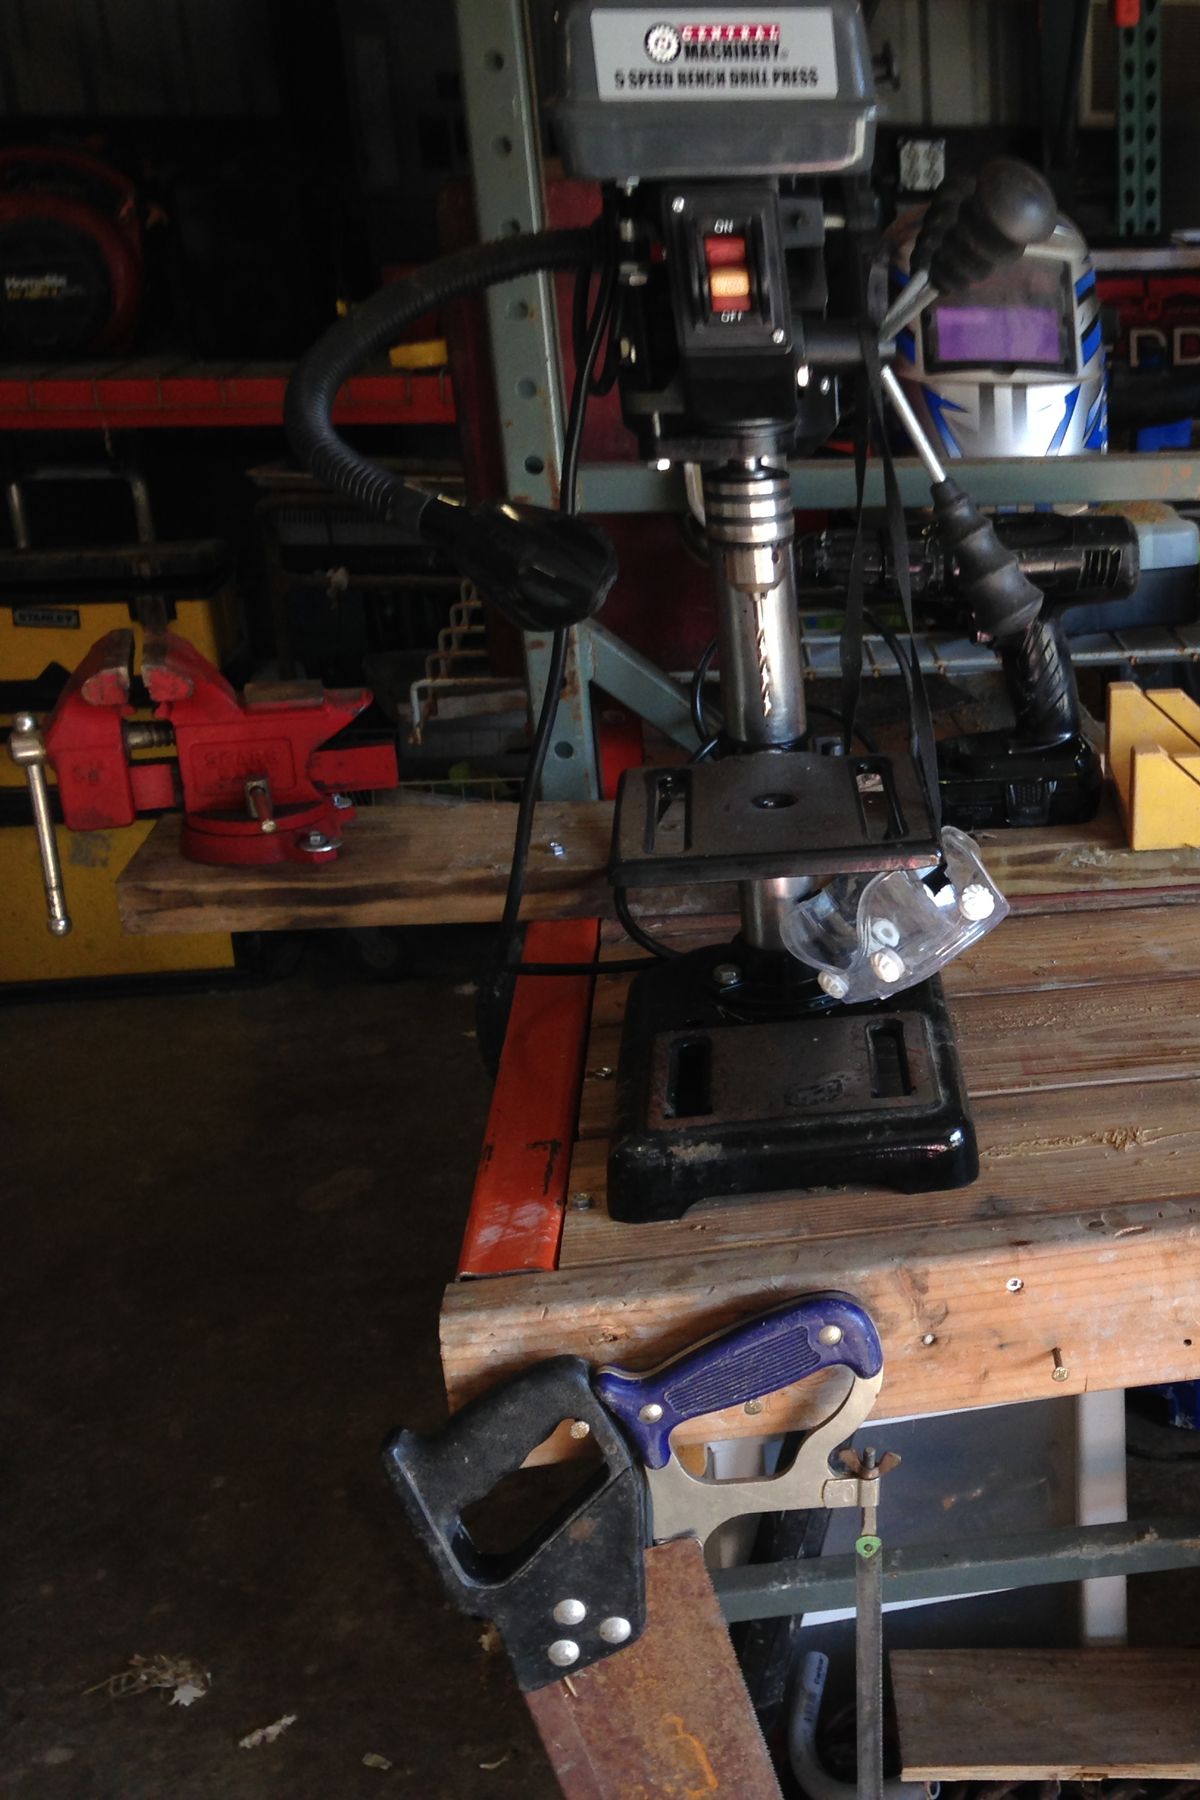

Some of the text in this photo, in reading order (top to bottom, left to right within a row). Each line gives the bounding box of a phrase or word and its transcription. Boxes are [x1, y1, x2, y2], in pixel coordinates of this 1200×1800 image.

[684, 43, 780, 62] MACHINERY
[628, 69, 674, 89] SPEED
[677, 68, 726, 89] BENCH
[729, 68, 769, 88] DRILL
[772, 68, 818, 88] PRESS
[713, 218, 734, 234] ON
[720, 310, 743, 323] OFF
